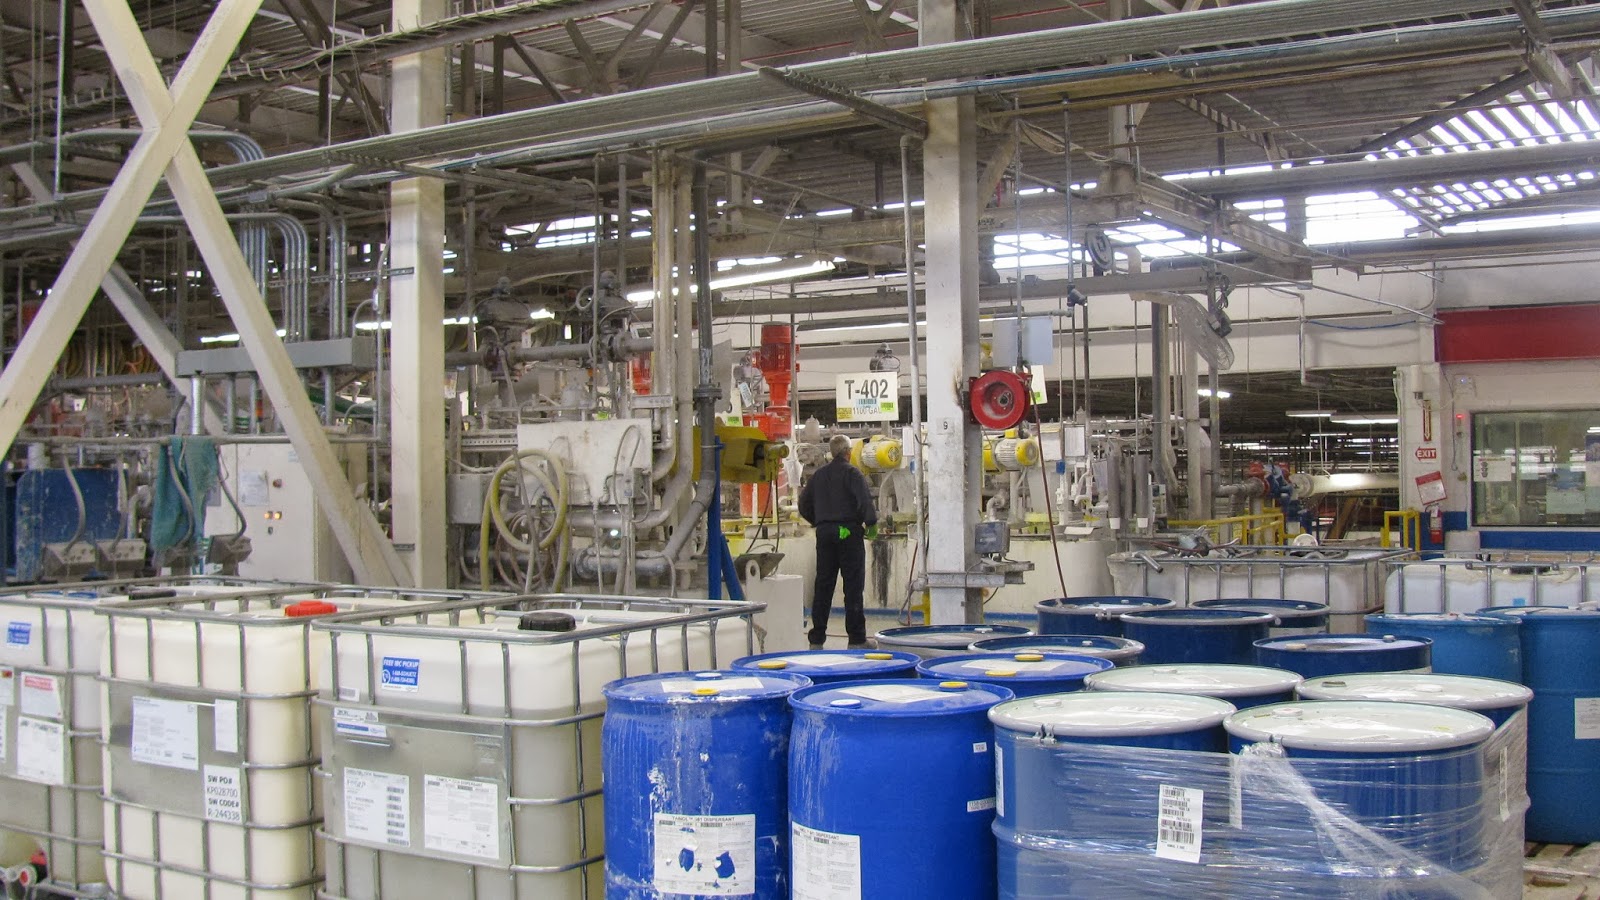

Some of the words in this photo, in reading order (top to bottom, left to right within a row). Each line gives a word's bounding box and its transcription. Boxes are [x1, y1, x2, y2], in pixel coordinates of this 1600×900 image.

[844, 379, 889, 400] T-402
[1417, 450, 1436, 458] EXIT
[208, 775, 218, 783] SW
